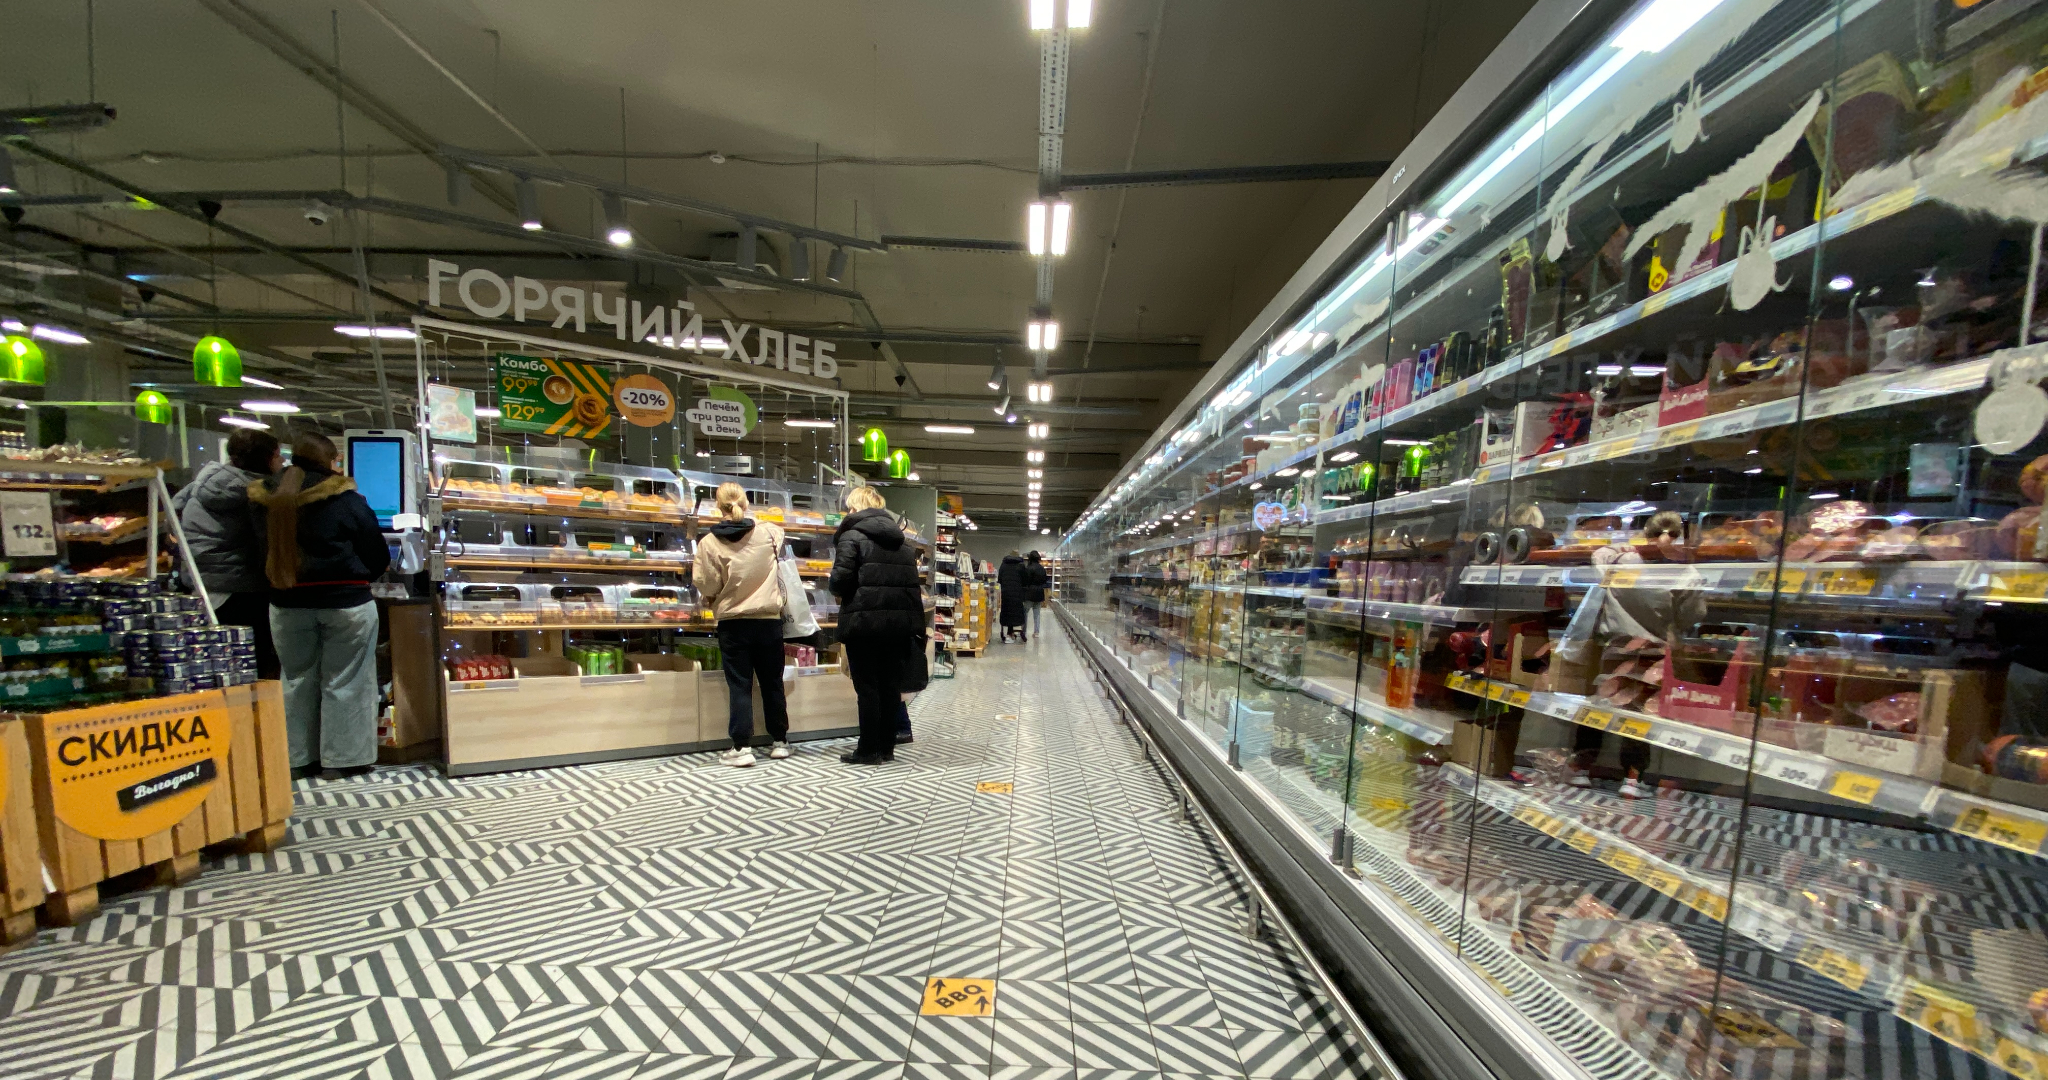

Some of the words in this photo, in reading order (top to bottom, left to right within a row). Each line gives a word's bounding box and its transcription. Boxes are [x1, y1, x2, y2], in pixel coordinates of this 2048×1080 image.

[428, 258, 702, 354] ГОРЯЧИЙ
[720, 319, 838, 379] ХЛЕБ
[500, 356, 548, 372] Комбо
[623, 392, 665, 406] -20%
[705, 402, 739, 412] Печём
[692, 413, 711, 421] три
[715, 414, 741, 423] раза
[716, 424, 741, 434] день
[13, 525, 43, 538] 132
[58, 715, 210, 766] СКИДКА
[134, 765, 201, 799] Выгодно!
[934, 985, 986, 1008] BBQ
